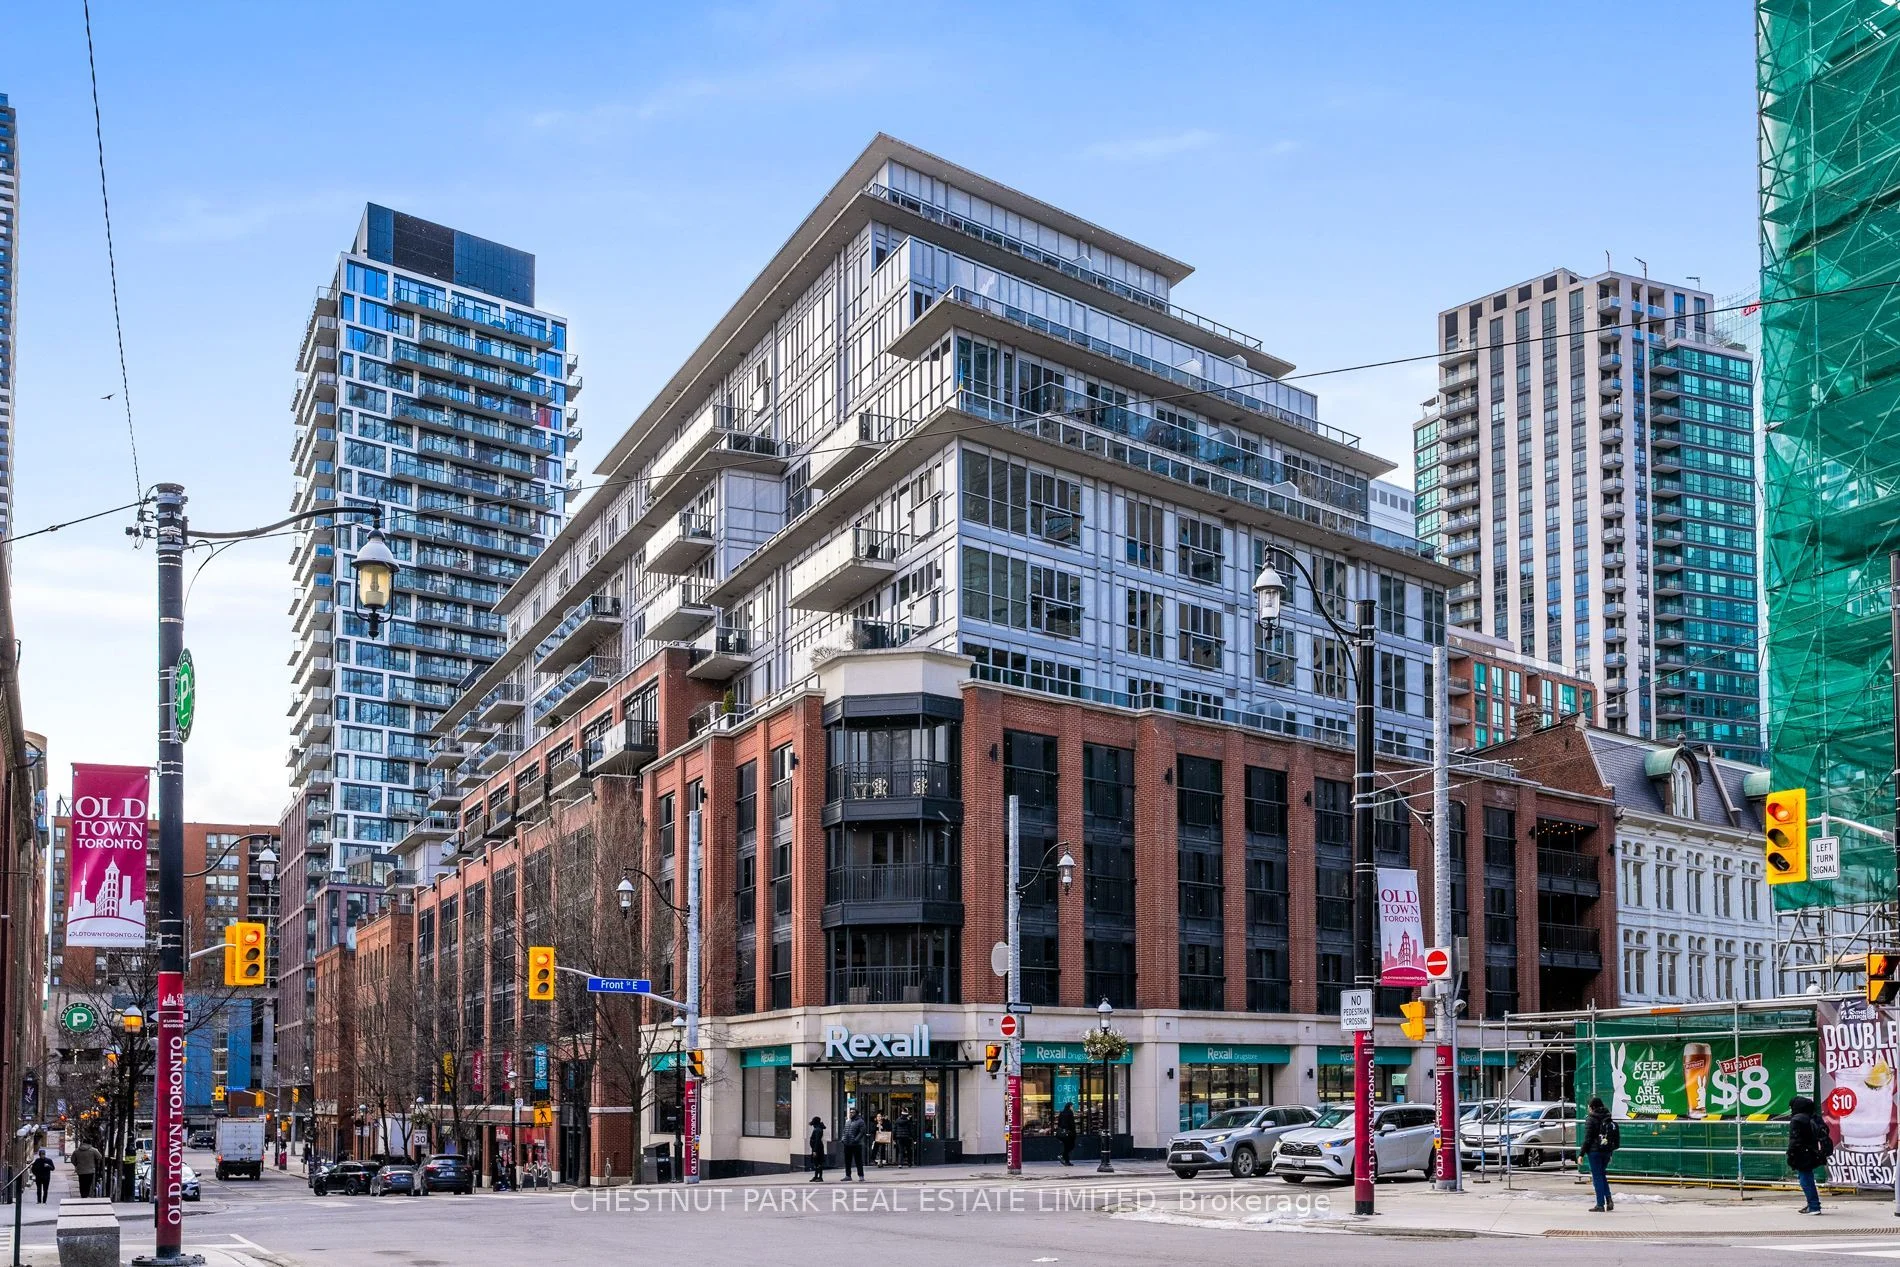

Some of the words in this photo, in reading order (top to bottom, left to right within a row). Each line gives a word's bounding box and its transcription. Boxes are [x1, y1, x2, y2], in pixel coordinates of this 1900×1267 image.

[75, 796, 146, 820] OLD
[75, 820, 145, 838] TOWN
[76, 838, 143, 850] TORONTO
[1816, 843, 1833, 853] LEFT
[1816, 854, 1834, 863] TURN
[1813, 865, 1837, 874] SIGNAL
[1381, 889, 1418, 904] OLD
[1381, 904, 1419, 916] TOWN
[1384, 915, 1420, 924] TORONTO
[600, 979, 624, 990] Front
[632, 980, 638, 990] E
[1351, 995, 1362, 1006] NO
[1343, 1007, 1370, 1017] PEDESTRIAN
[72, 1012, 88, 1027] P
[1345, 1017, 1368, 1026] CROSSING
[1822, 1020, 1897, 1051] DOUBLE
[824, 1024, 930, 1061] Rexall
[1036, 1046, 1067, 1060] Rexall
[1207, 1047, 1233, 1060] Rexall
[1233, 1053, 1259, 1061] Drugstore
[1634, 1061, 1666, 1071] KEEP
[1825, 1050, 1860, 1073] BAR
[170, 1036, 183, 1118] TORONTO
[1632, 1070, 1665, 1080] CALM
[1056, 1084, 1077, 1093] OPEN
[1642, 1079, 1656, 1087] WE
[1711, 1065, 1772, 1110] $8
[1637, 1086, 1660, 1095] ARE
[1057, 1095, 1076, 1105] LATE
[1635, 1094, 1665, 1105] OPEN
[1832, 1094, 1852, 1110] $10
[414, 1135, 426, 1144] 30
[168, 1123, 182, 1180] TOWN
[1827, 1149, 1884, 1167] SUNDAY
[1828, 1165, 1897, 1184] WEDNESDA
[168, 1182, 182, 1225] OLD
